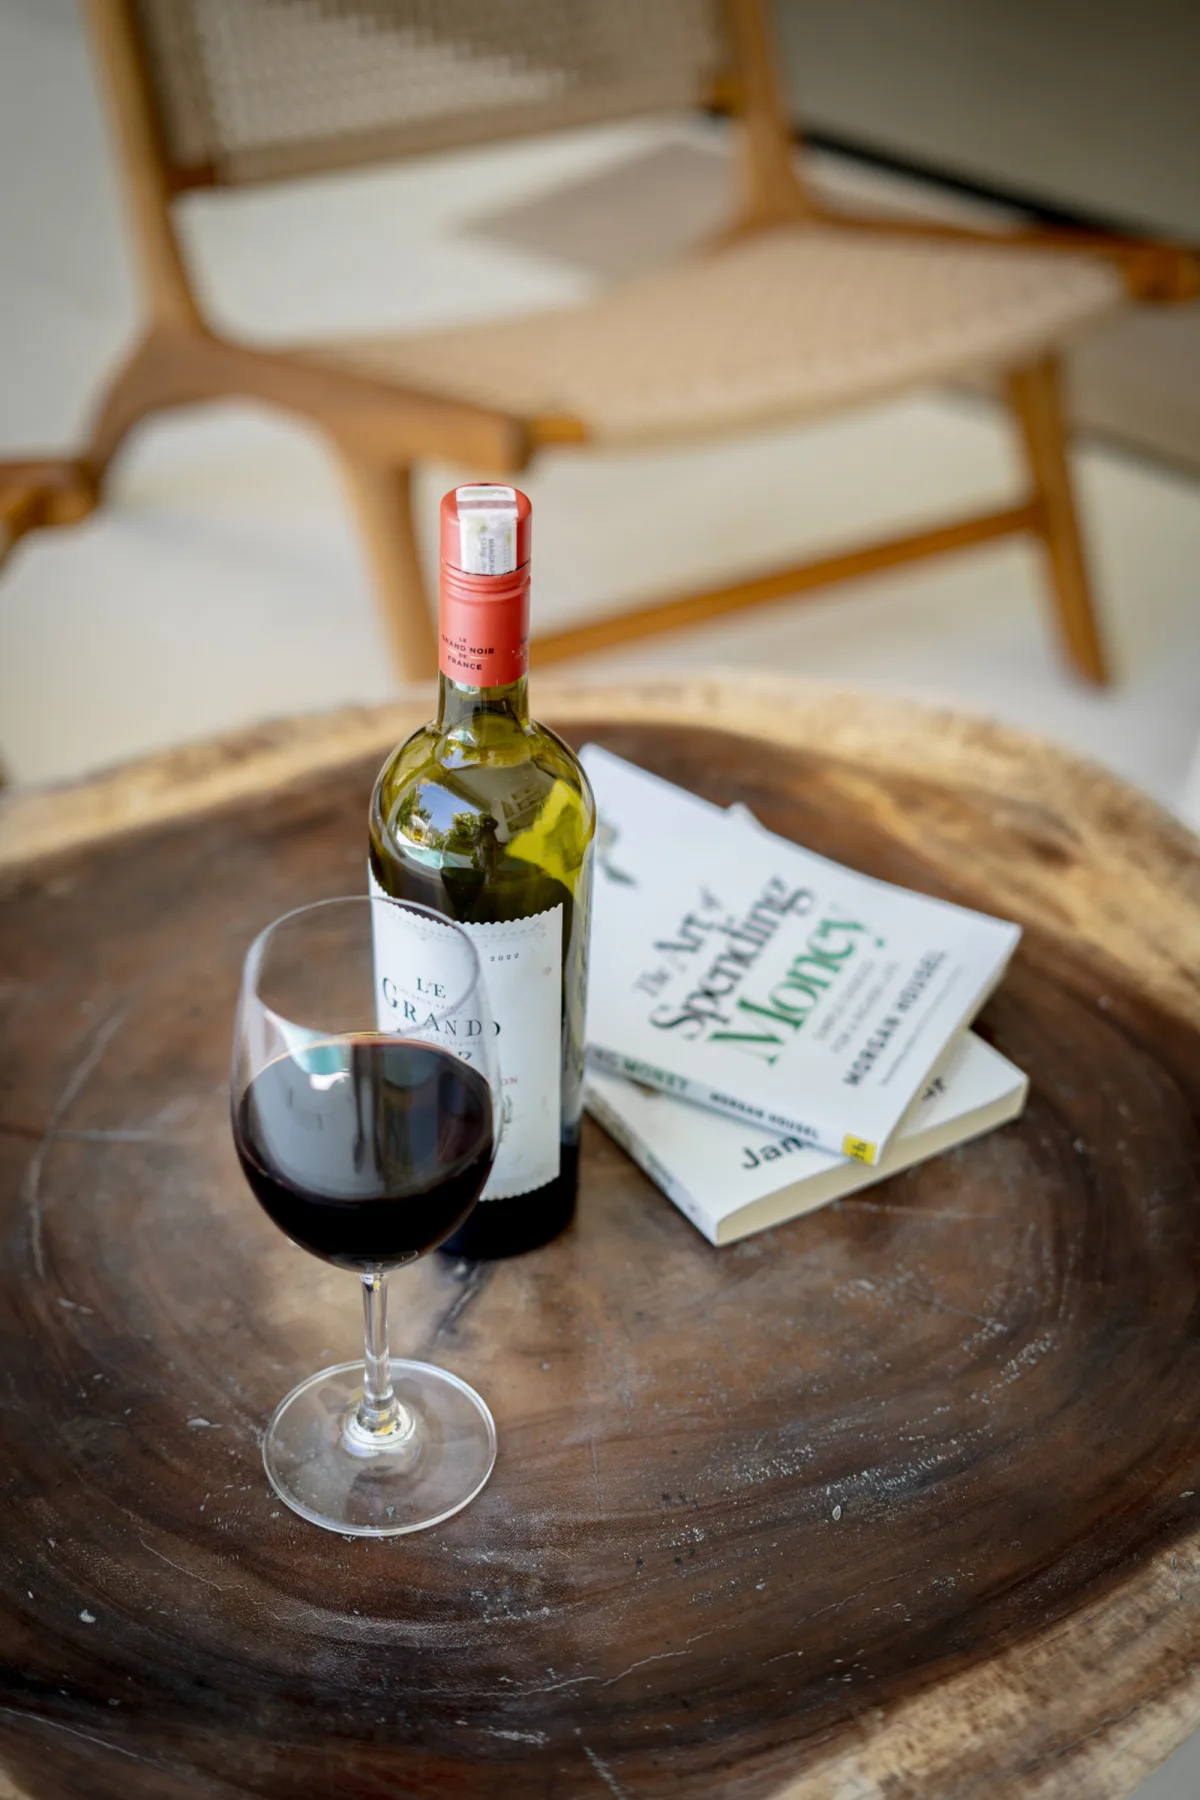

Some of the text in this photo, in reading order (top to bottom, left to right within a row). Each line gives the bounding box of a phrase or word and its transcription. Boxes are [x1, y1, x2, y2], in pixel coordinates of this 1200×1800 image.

[441, 634, 495, 655] GRAND NOIR
[448, 655, 483, 671] FRANCE
[490, 953, 520, 962] 2022
[648, 875, 815, 1042] Spending
[653, 913, 716, 975] Art
[416, 976, 447, 999] LE
[705, 902, 886, 1065] Money
[842, 1016, 901, 1087] MORGAN
[896, 950, 948, 1014] HOUSEL
[622, 1057, 690, 1090] MONEY
[709, 1091, 765, 1119] MORGAN
